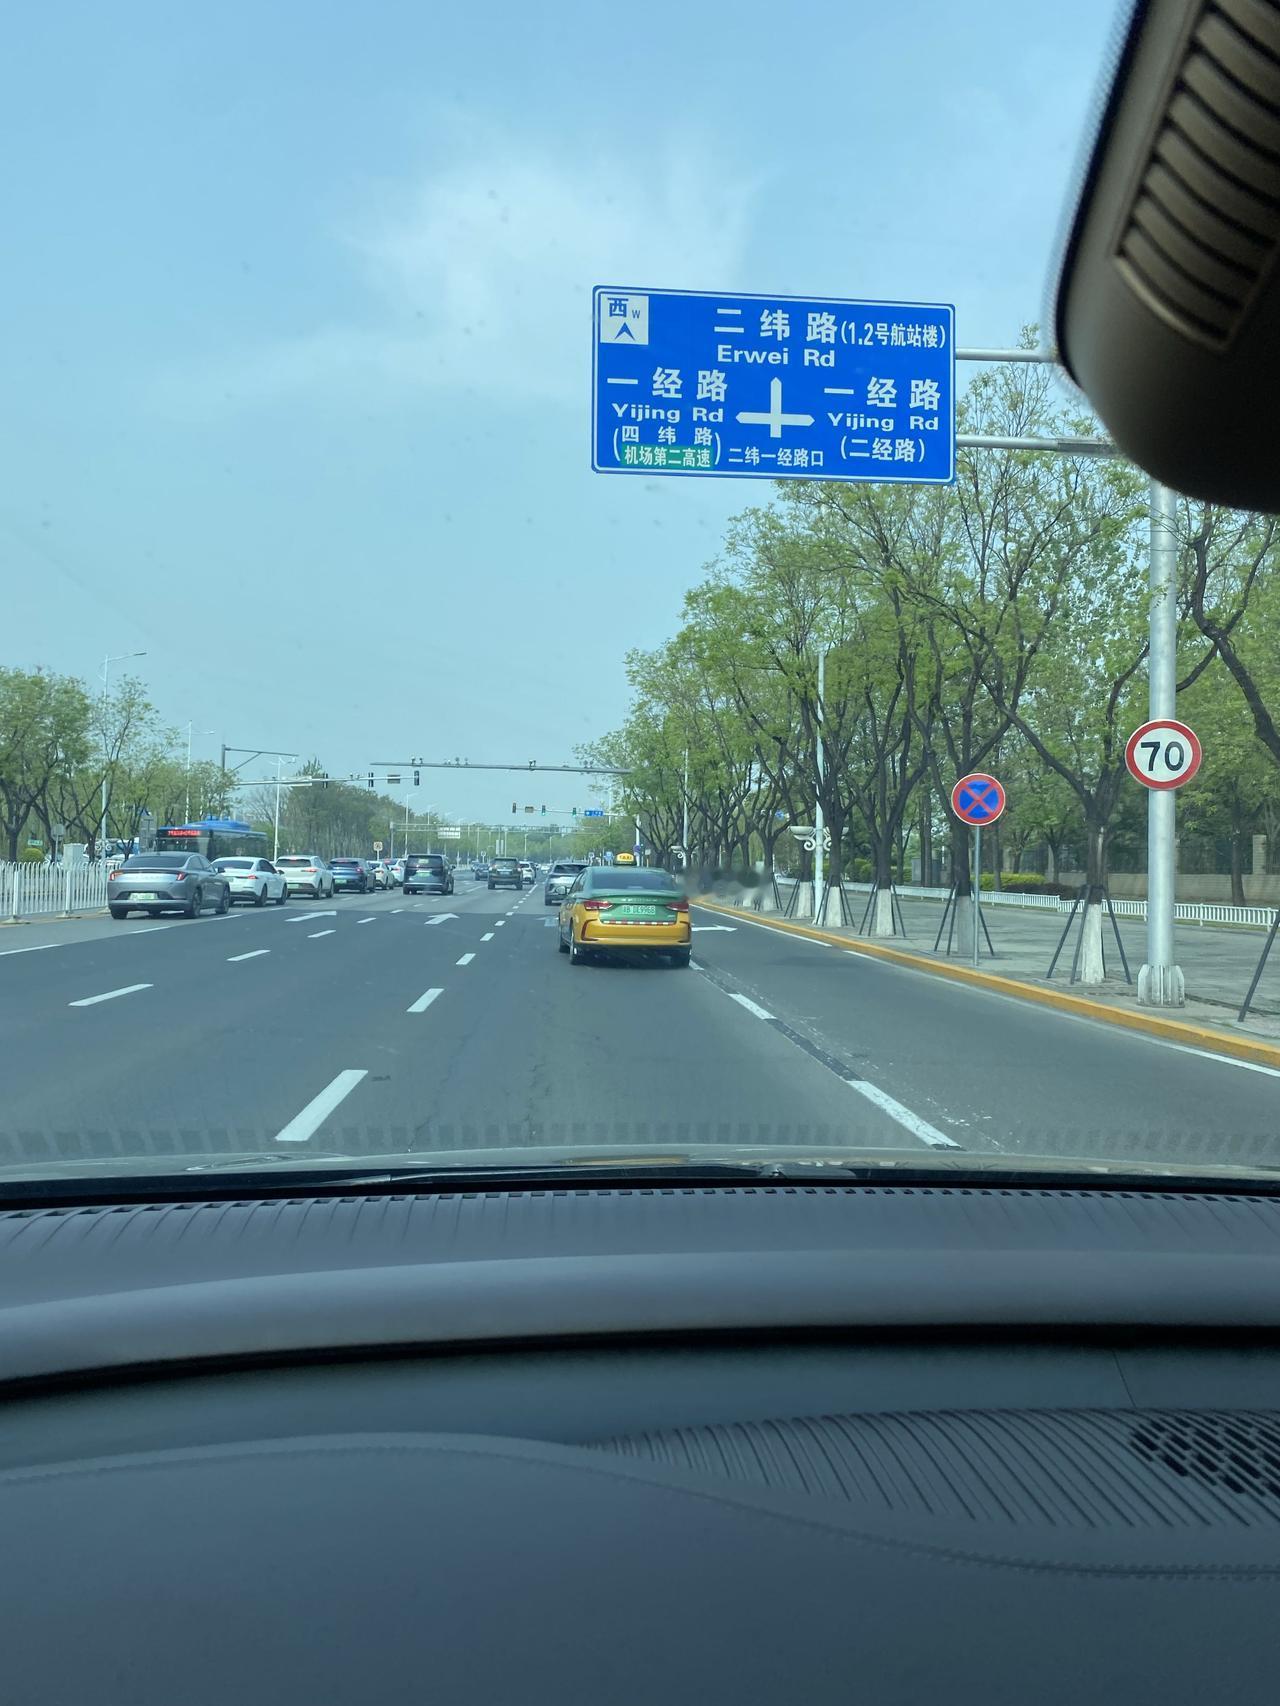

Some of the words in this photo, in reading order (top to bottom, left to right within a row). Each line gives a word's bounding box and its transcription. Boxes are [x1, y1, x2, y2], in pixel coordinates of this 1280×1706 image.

[607, 297, 629, 318] 西
[631, 309, 641, 319] W
[714, 308, 838, 344] 二纬路
[717, 344, 789, 365] Erwei
[803, 349, 835, 367] Rd
[607, 366, 728, 402] 一经路
[824, 376, 941, 411] 一经路
[611, 403, 681, 423] Yijing
[692, 407, 724, 423] Rd
[827, 412, 894, 432] Yijing
[909, 415, 939, 431] Rd
[728, 446, 824, 468] 二纬一经路口
[840, 435, 926, 463] (二经路)
[1140, 741, 1185, 771] 70
